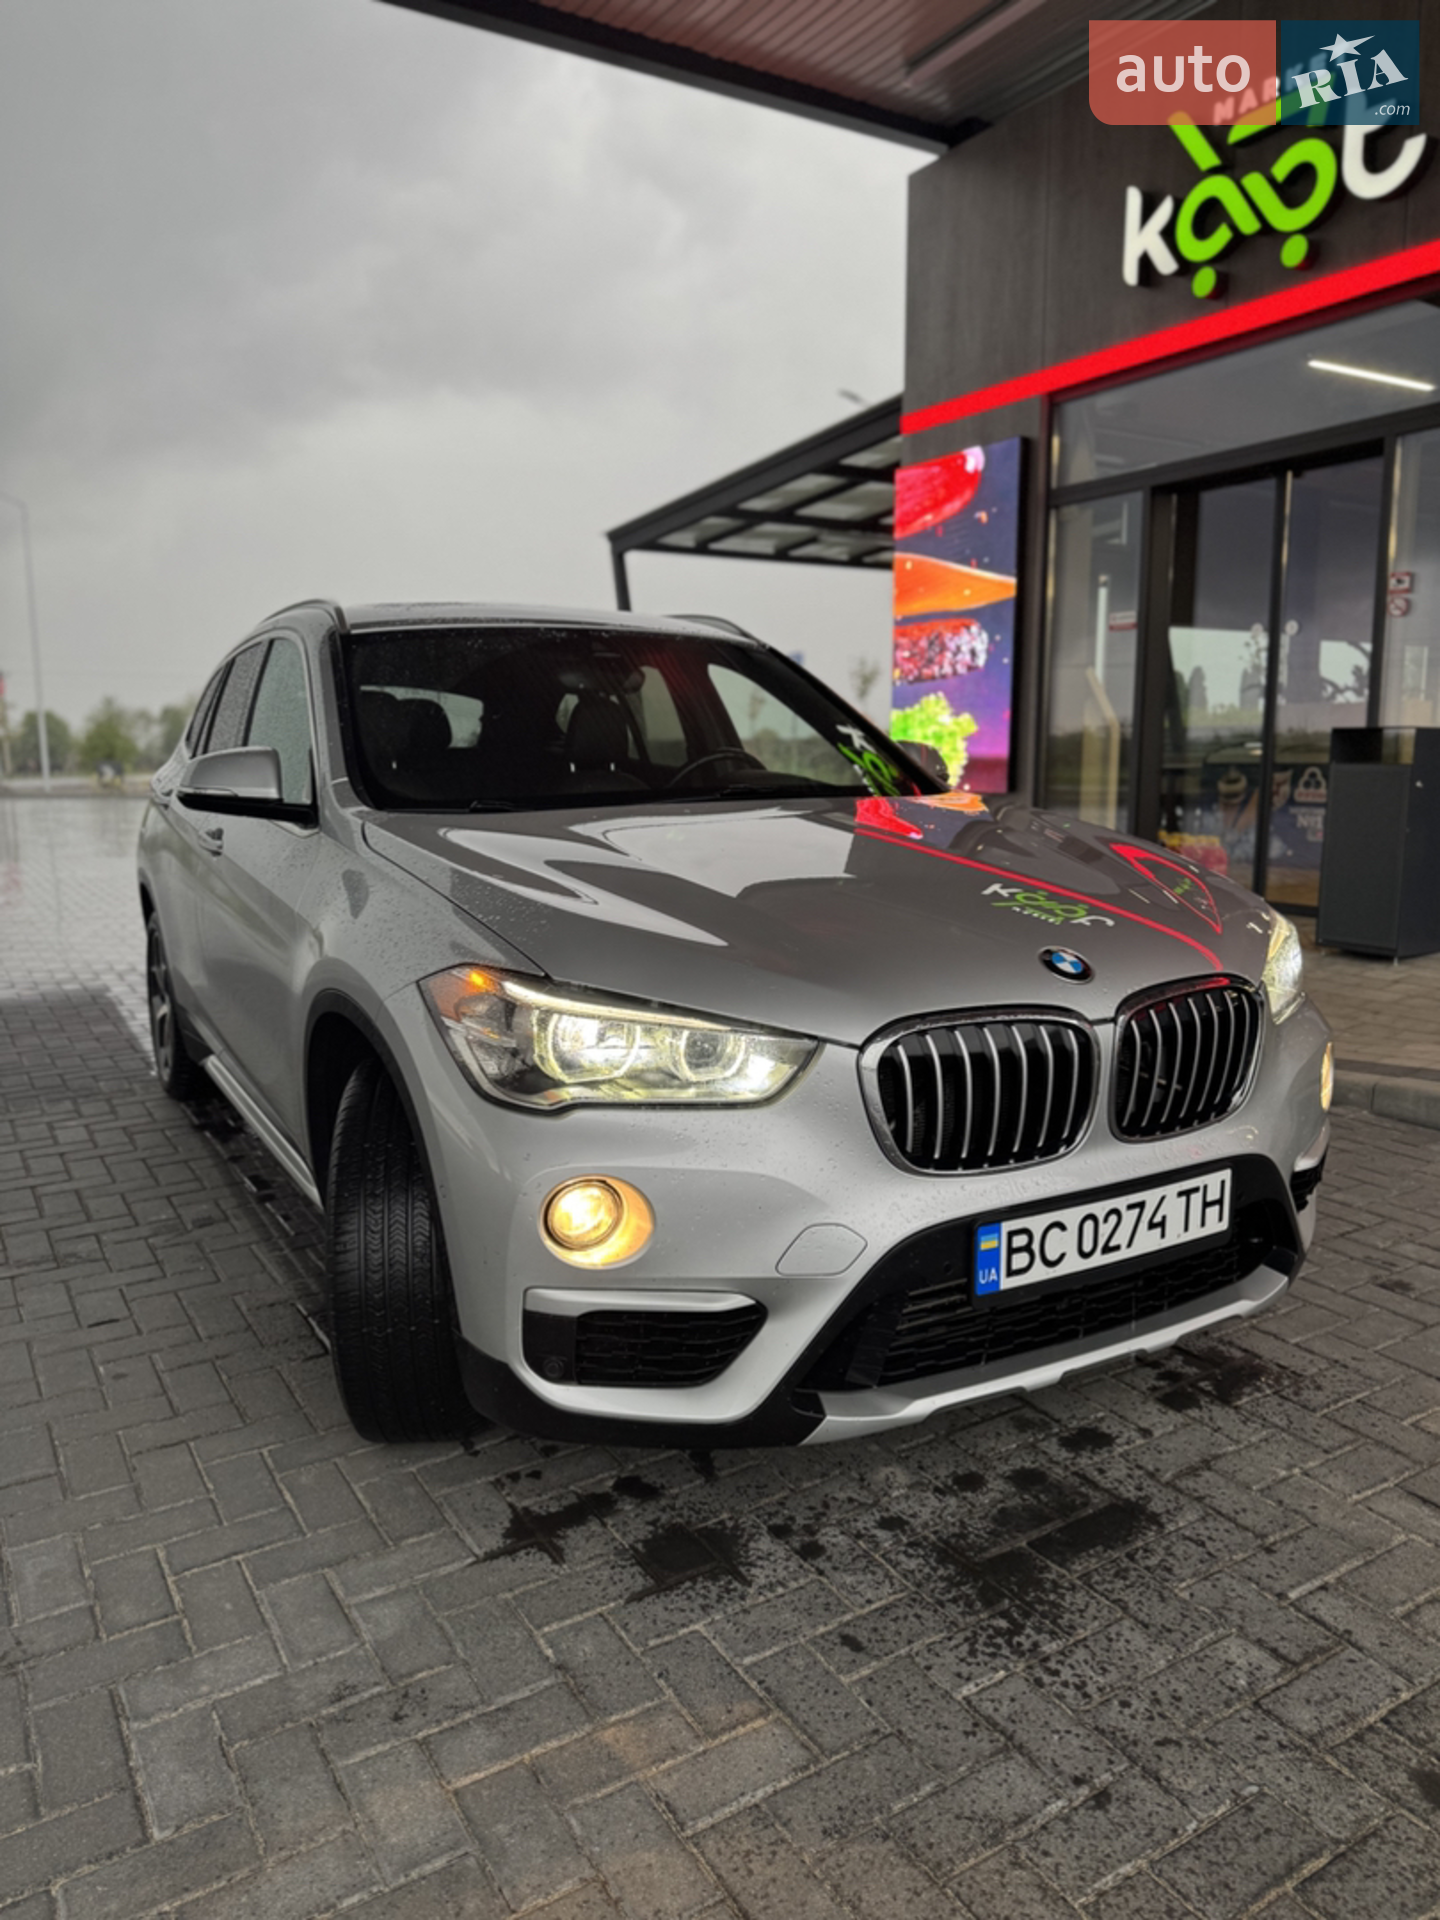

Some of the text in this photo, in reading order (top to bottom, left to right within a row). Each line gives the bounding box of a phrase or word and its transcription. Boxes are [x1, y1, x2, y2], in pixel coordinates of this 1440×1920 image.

[1006, 1179, 1226, 1278] BC 0274 TH
[979, 1267, 998, 1284] UA
